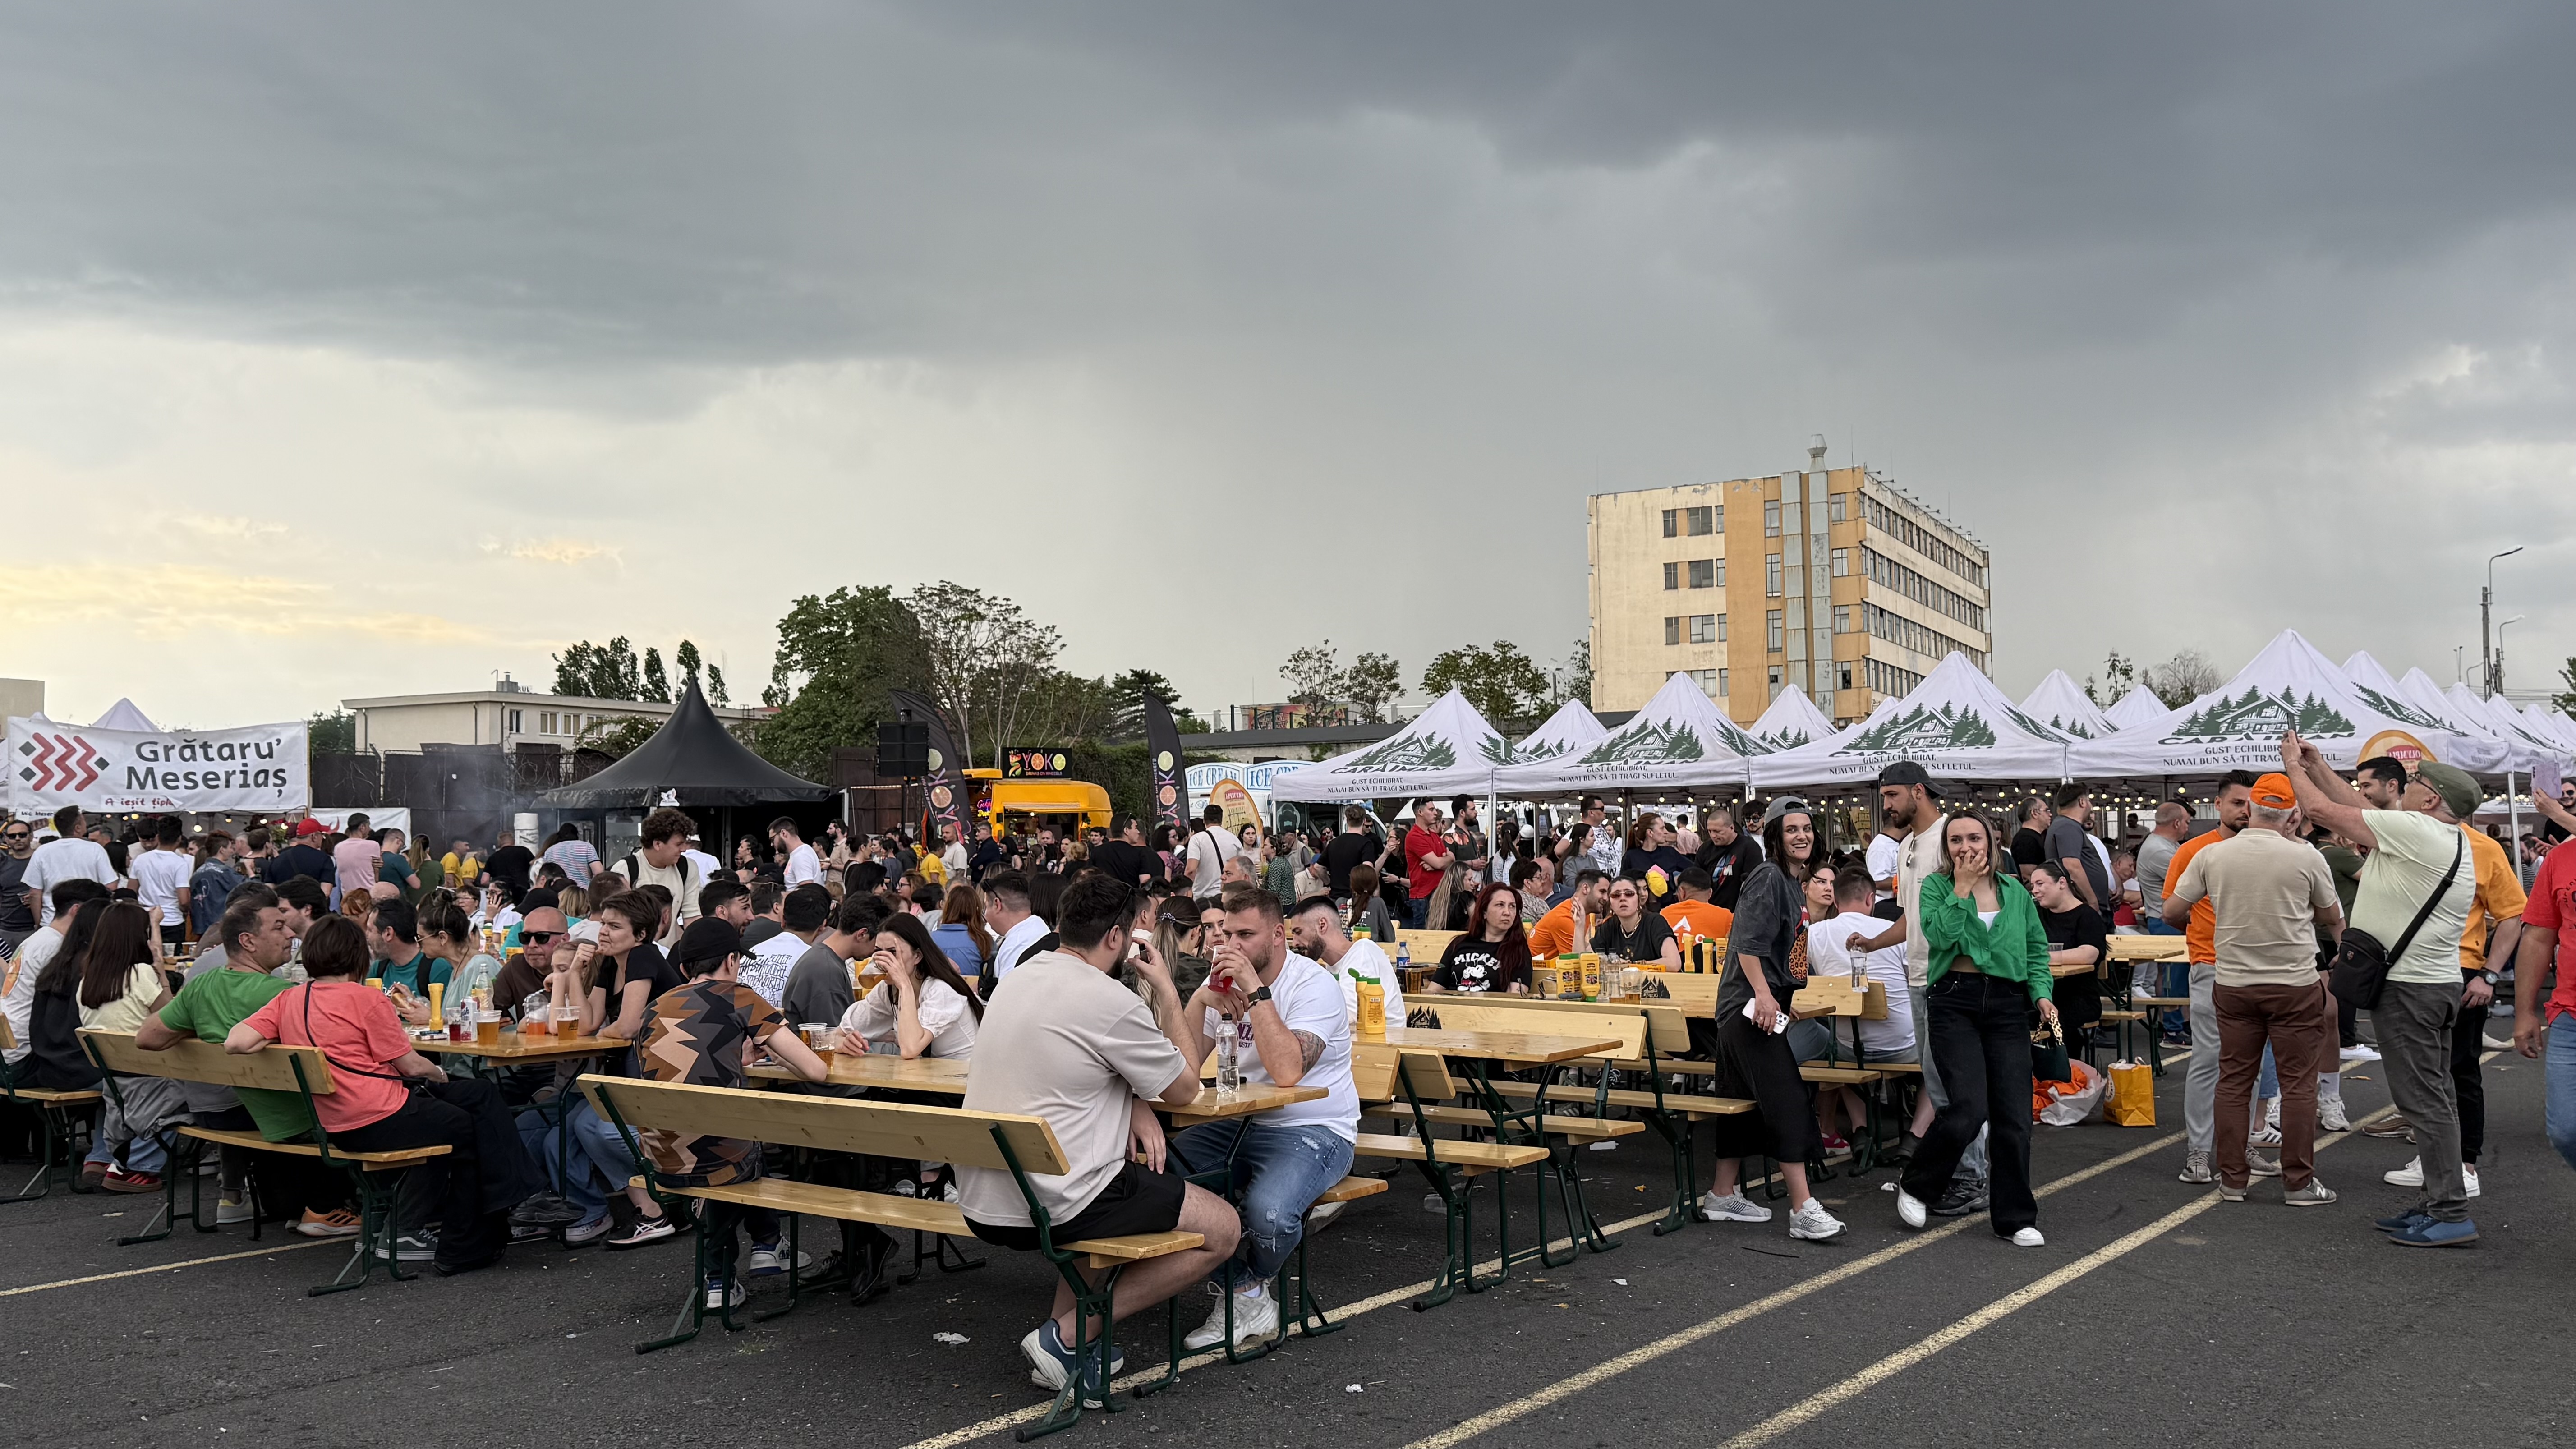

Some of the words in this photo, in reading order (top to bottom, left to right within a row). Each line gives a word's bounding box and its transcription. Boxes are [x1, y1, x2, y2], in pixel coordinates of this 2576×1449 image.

[135, 738, 281, 762] Grătaru'
[2205, 746, 2231, 754] GUST
[2235, 744, 2280, 753] ECHILIBR
[1022, 753, 1066, 771] YOKO
[1863, 755, 1884, 764] GUST
[126, 763, 287, 798] Meseriaș
[1189, 770, 1203, 786] ICE
[1250, 768, 1272, 787] ICE
[105, 798, 114, 806] A
[1454, 952, 1501, 971] MICKEY
